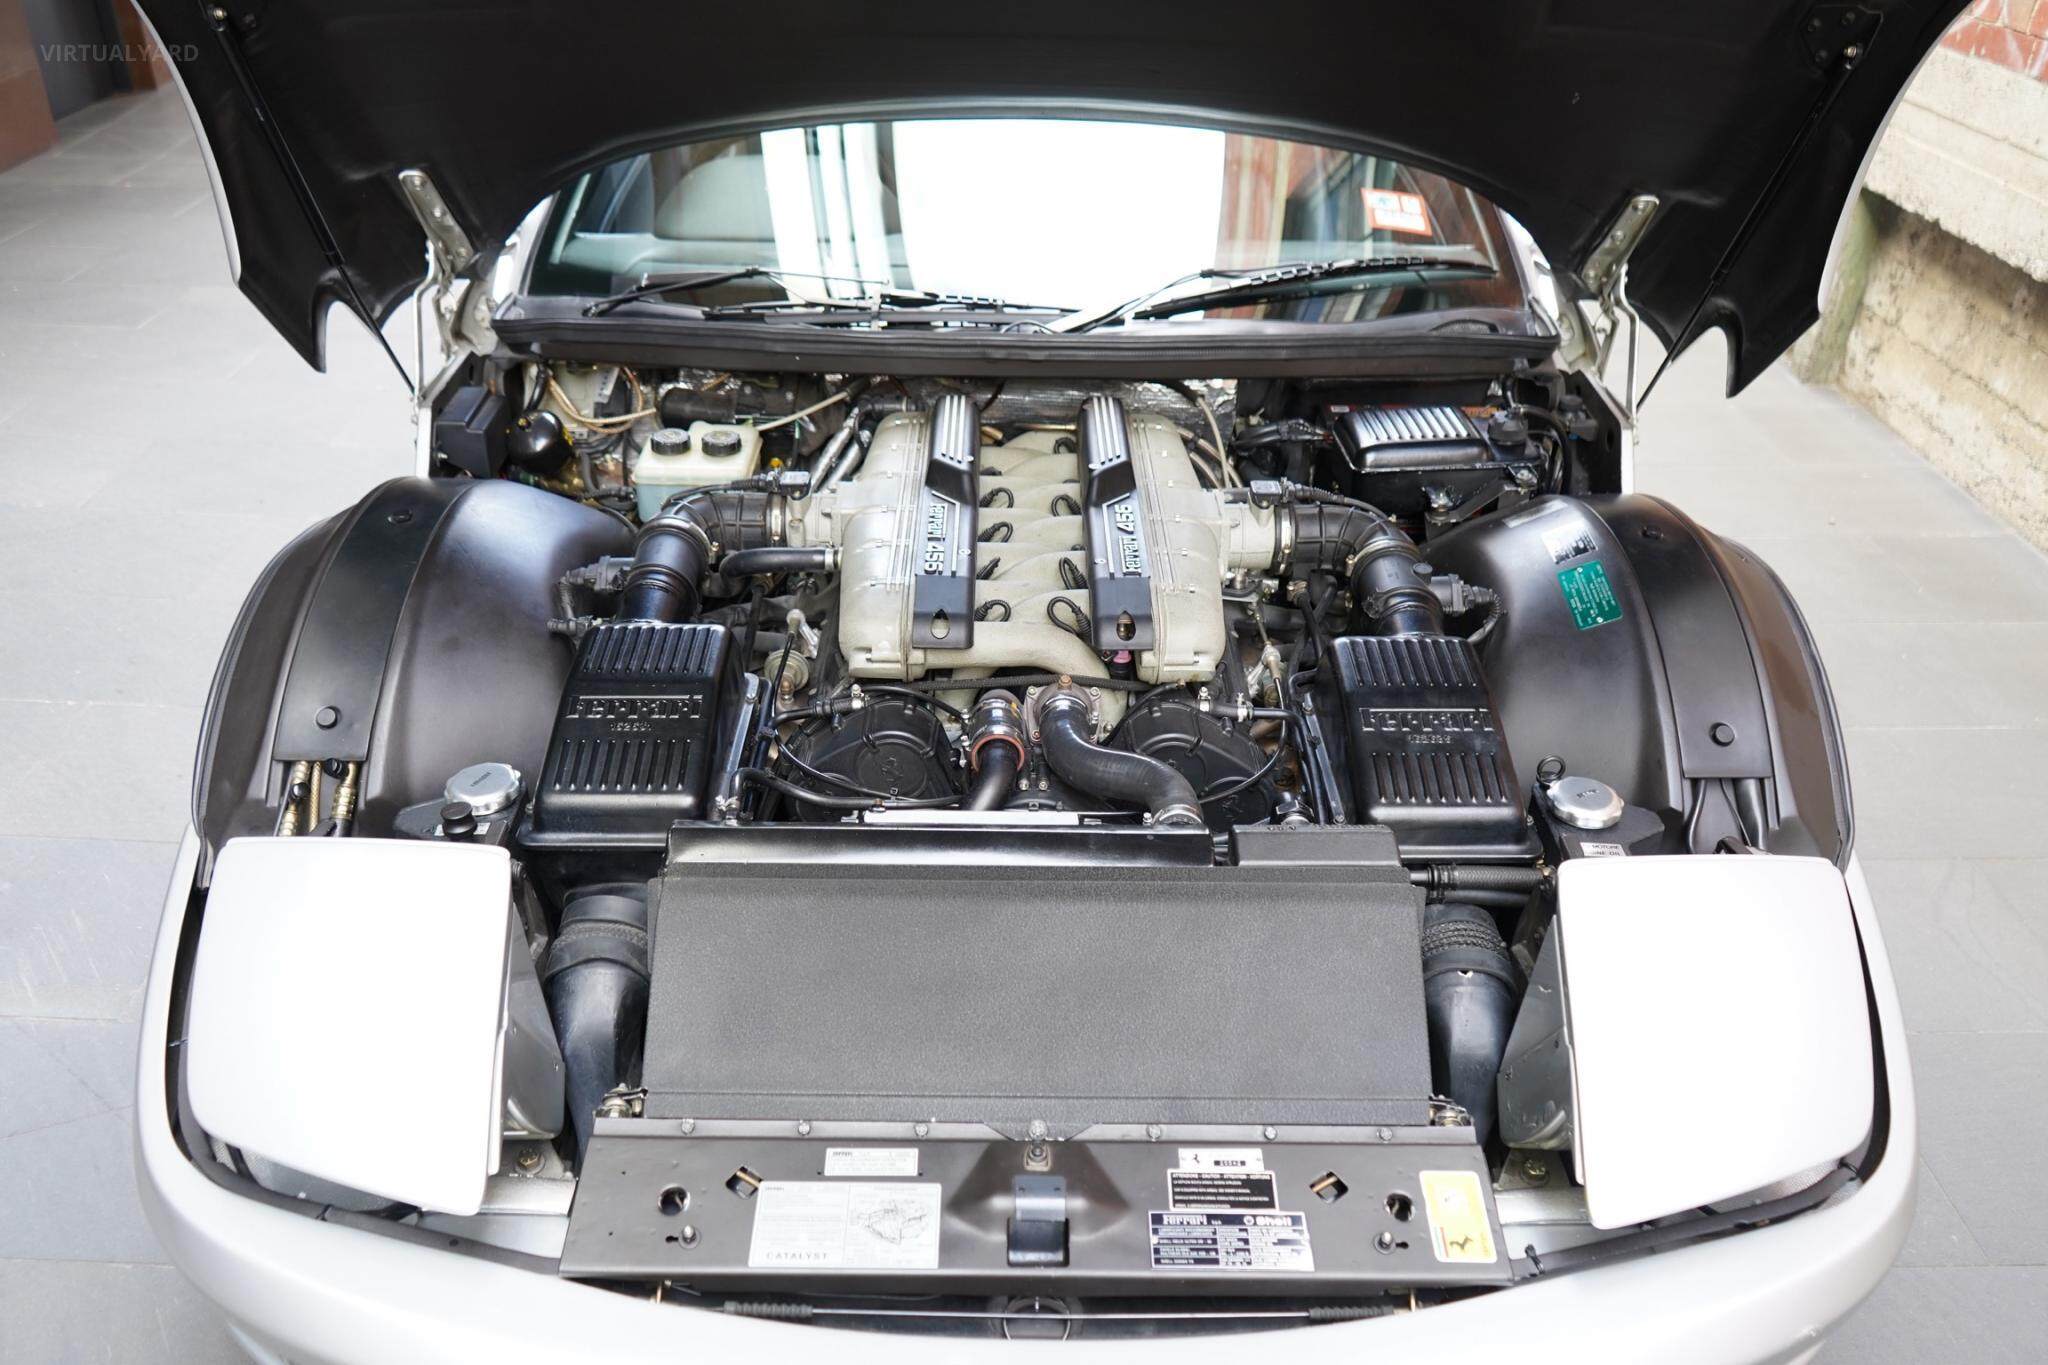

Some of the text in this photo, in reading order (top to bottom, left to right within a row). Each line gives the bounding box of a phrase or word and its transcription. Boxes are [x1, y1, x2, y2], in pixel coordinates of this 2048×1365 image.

[924, 502, 948, 575] Ferrari 456
[1114, 504, 1141, 576] Ferrari 456
[565, 694, 703, 719] Ferrari
[1359, 708, 1494, 731] Ferrari
[1162, 1214, 1207, 1225] Ferrari
[1256, 1215, 1292, 1226] Shell
[766, 1252, 828, 1260] CATALYST
